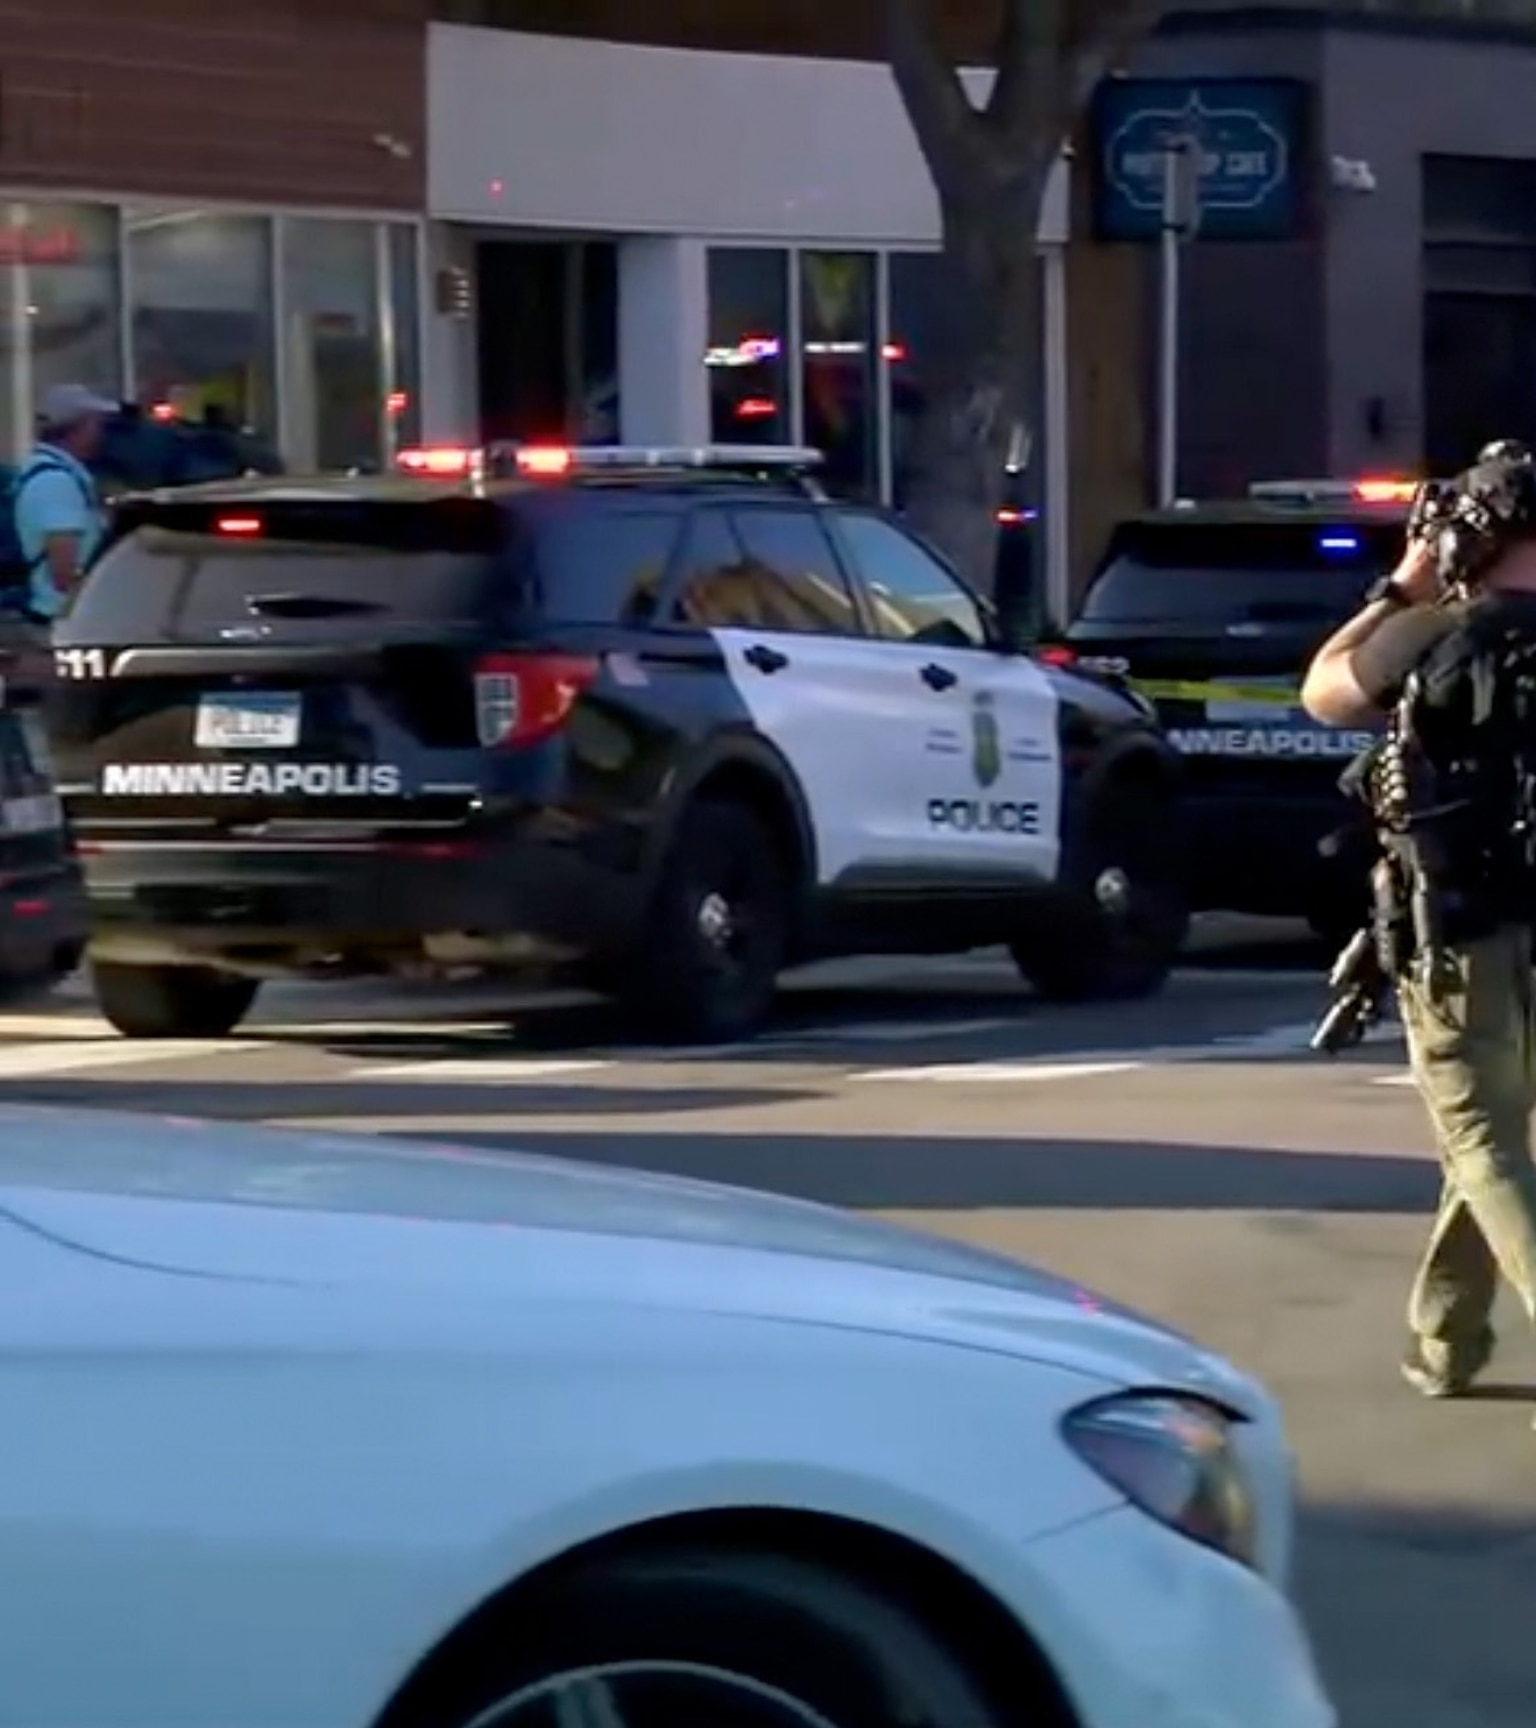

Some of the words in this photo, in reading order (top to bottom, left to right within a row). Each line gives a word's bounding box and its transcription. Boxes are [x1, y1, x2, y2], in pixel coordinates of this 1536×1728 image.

[1166, 728, 1374, 755] NNEAPOLIS
[102, 763, 400, 795] MINNEAPOLIS
[928, 798, 1040, 836] POLICE
